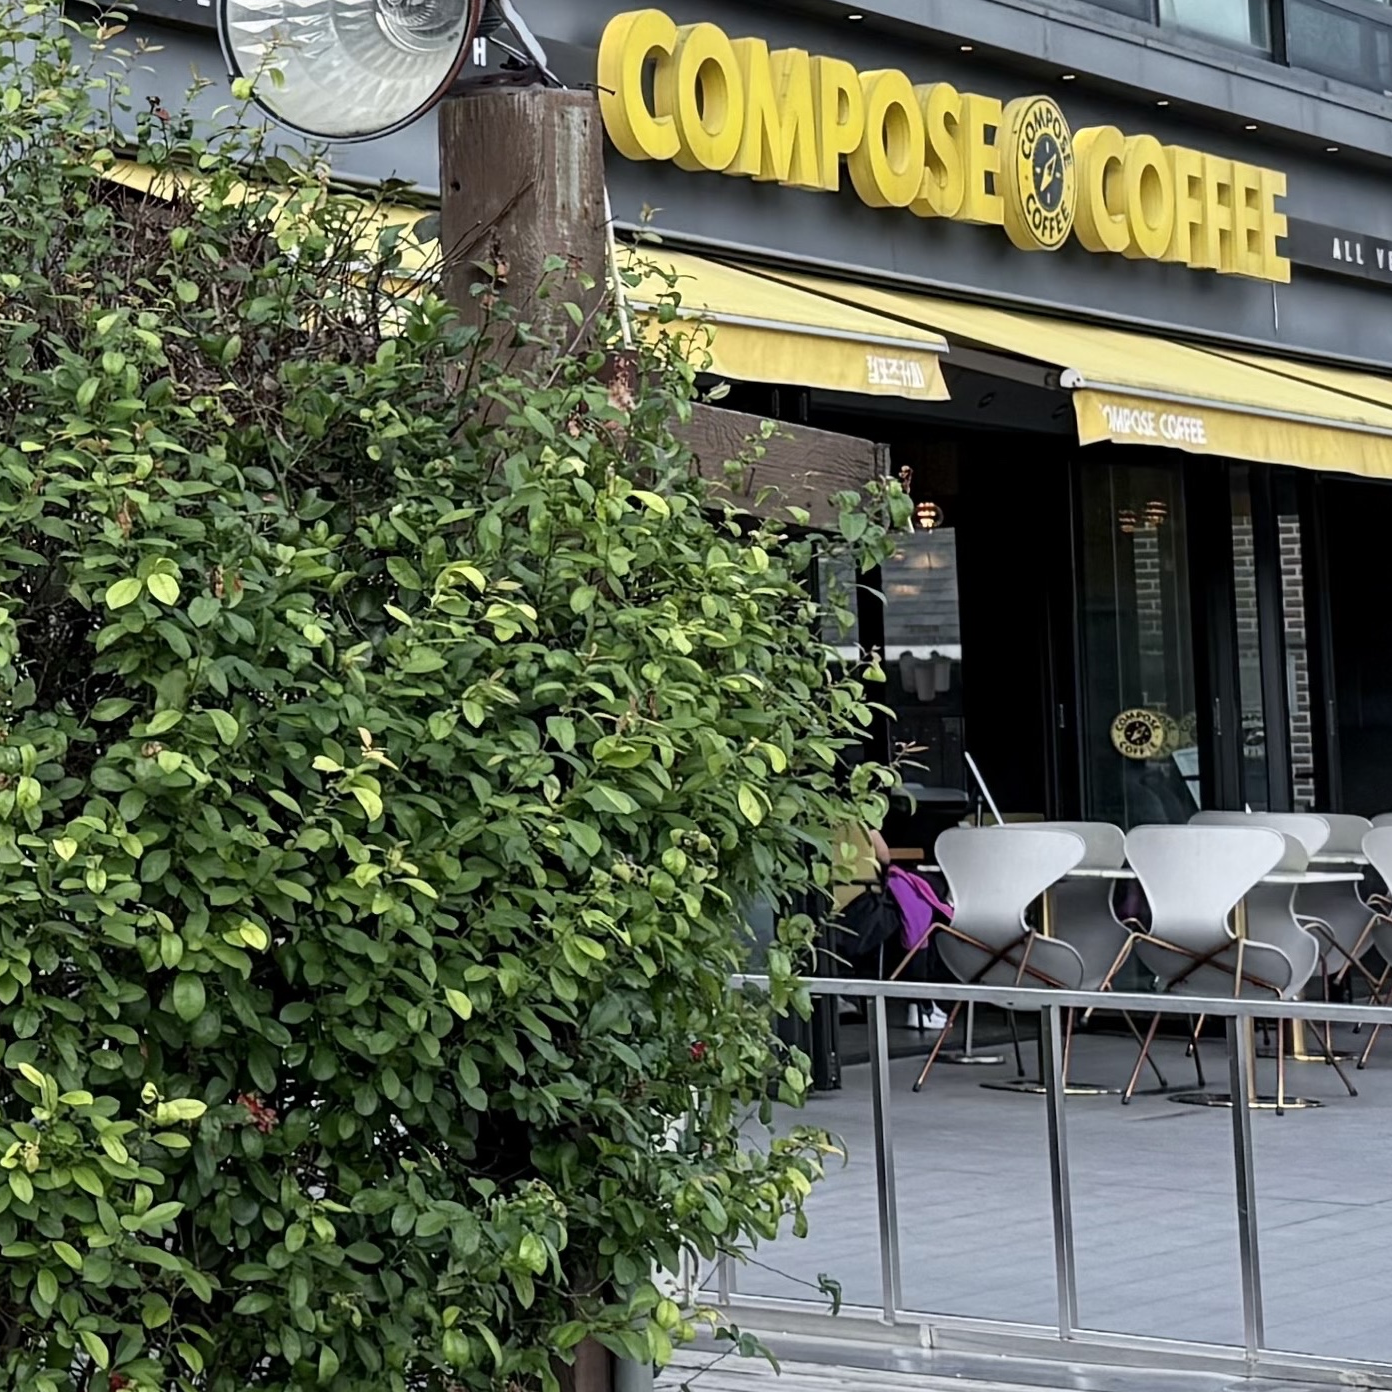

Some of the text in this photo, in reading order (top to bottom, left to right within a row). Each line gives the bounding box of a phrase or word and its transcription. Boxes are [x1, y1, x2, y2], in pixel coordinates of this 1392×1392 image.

[597, 8, 1291, 284] COMPOSE COFFEE
[1021, 106, 1073, 240] COMPOSE COFFEE
[1332, 237, 1364, 265] ALL
[1099, 404, 1207, 445] OMPOSE COFFEE
